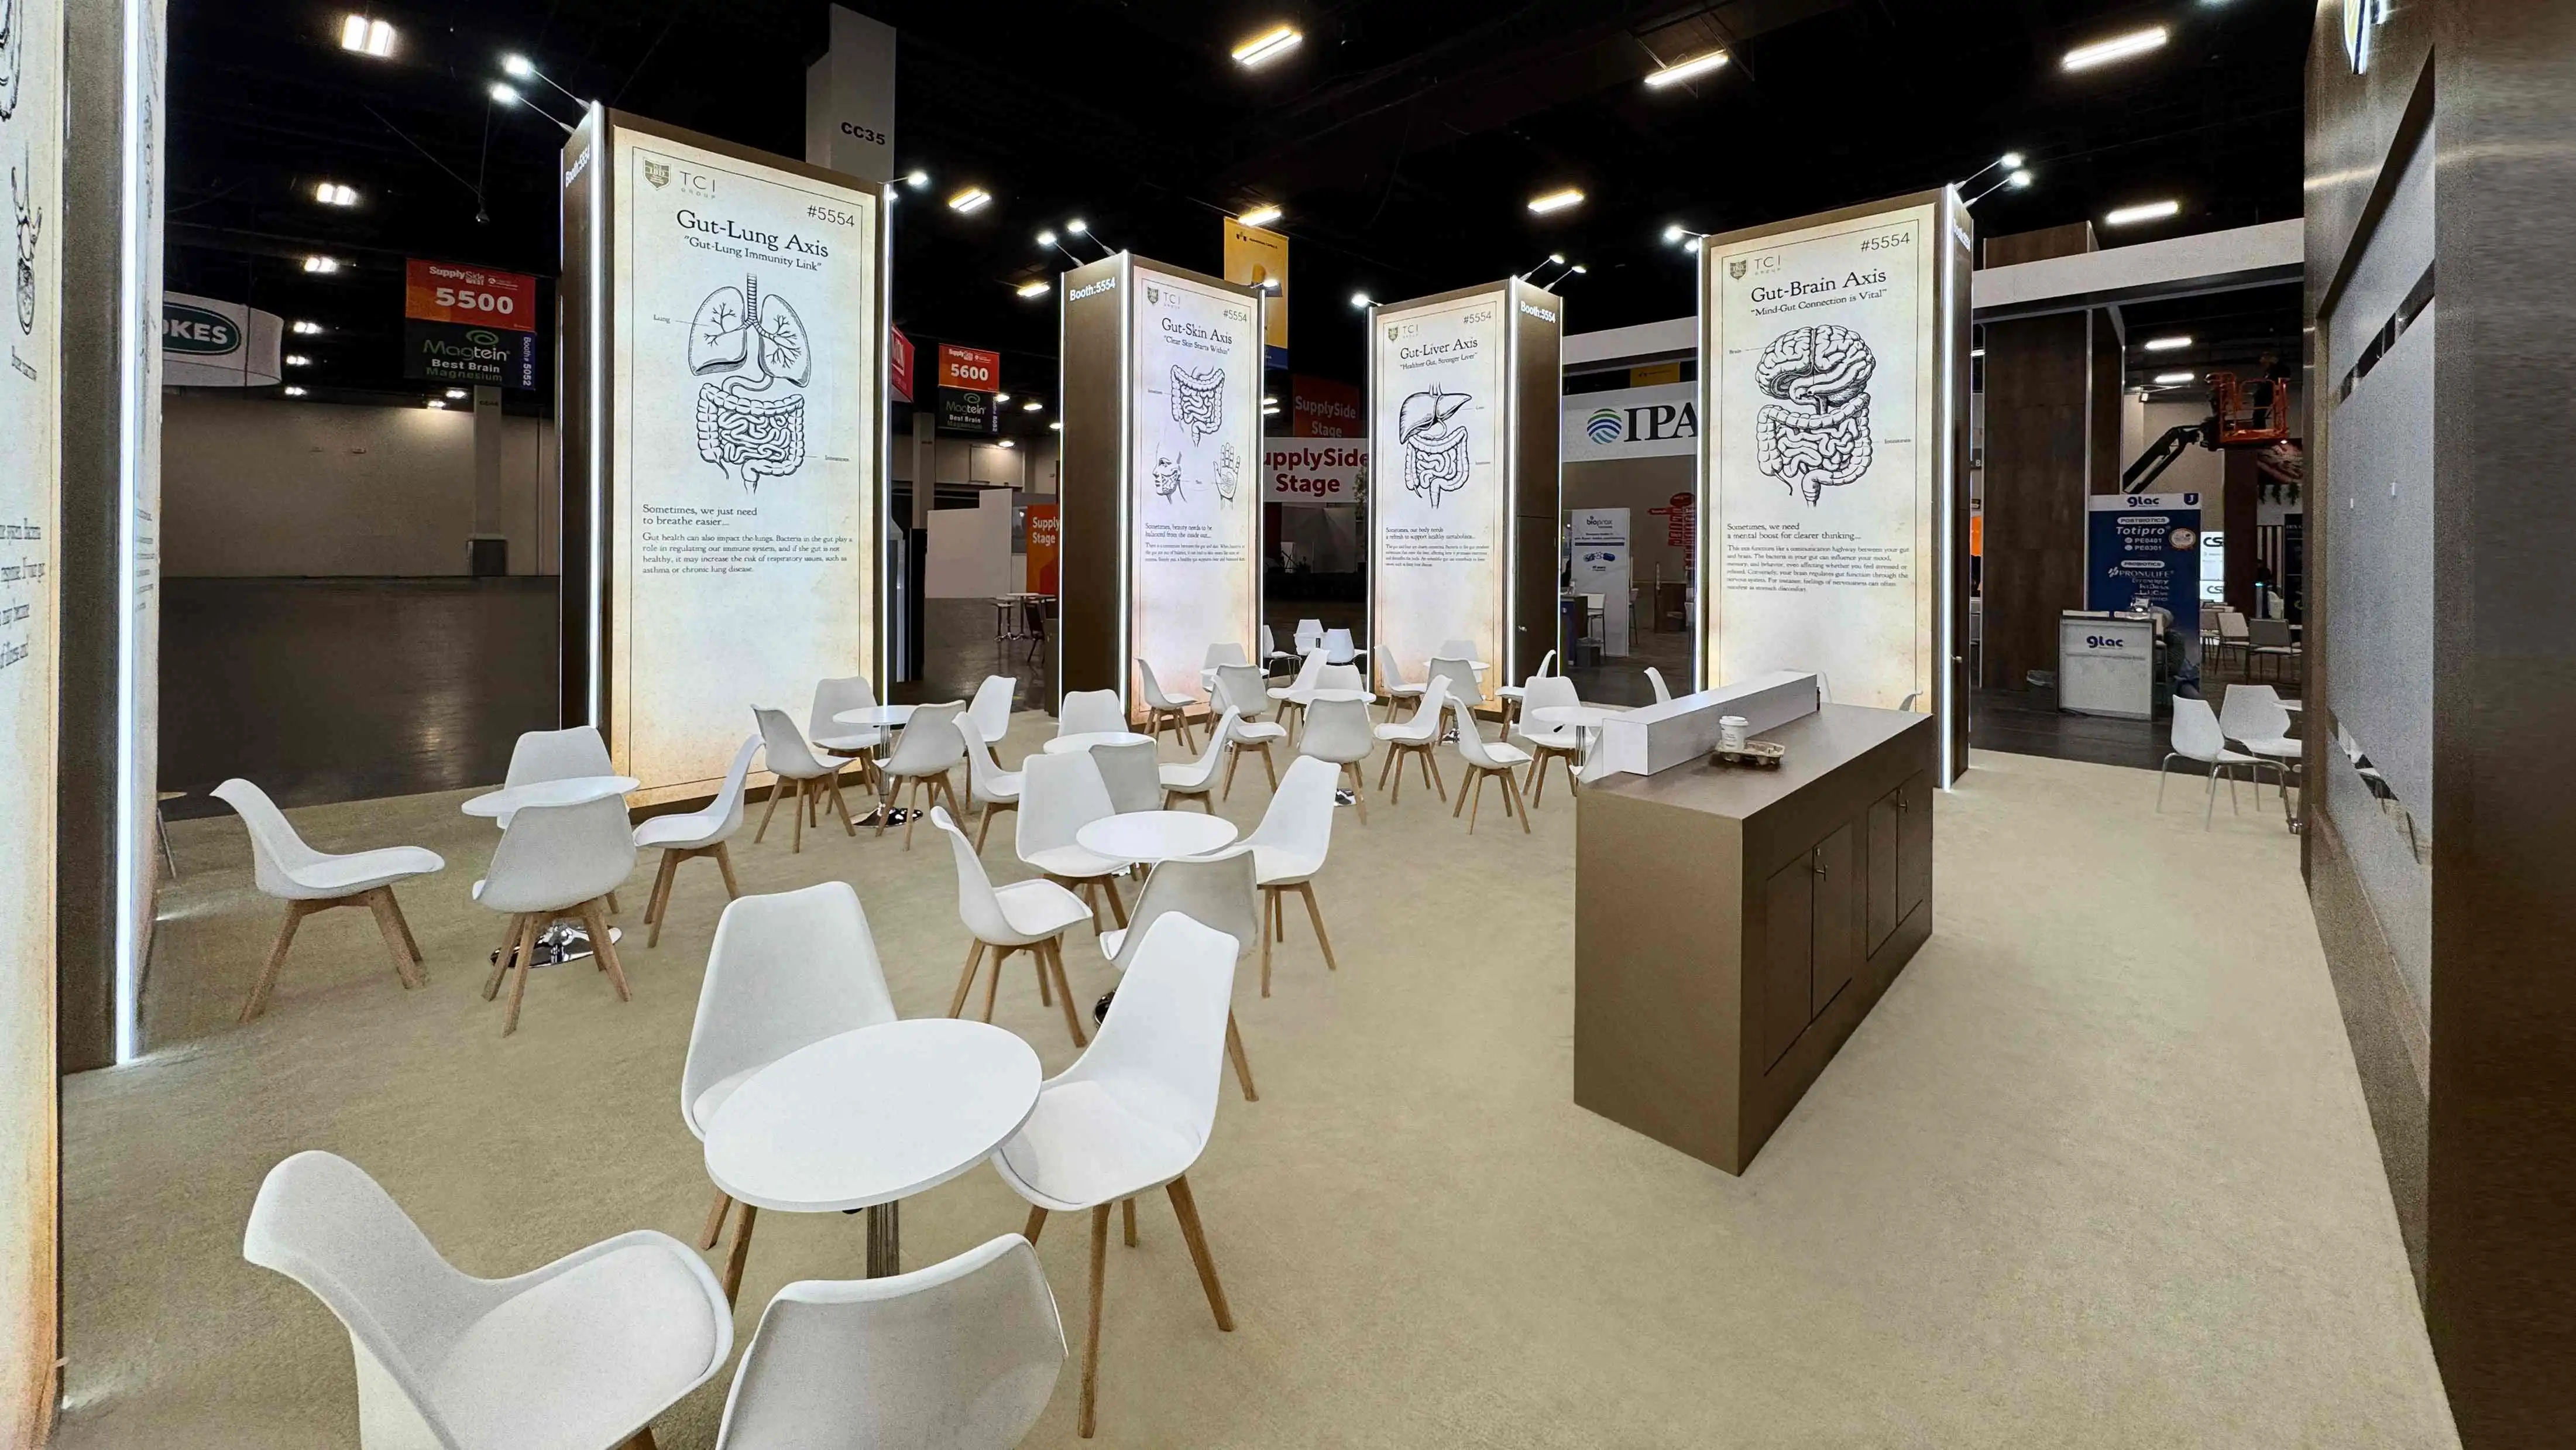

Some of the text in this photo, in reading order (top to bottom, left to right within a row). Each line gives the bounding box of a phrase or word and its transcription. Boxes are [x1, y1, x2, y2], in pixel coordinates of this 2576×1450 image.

[842, 122, 885, 145] CC35
[679, 171, 716, 193] TCI
[681, 187, 716, 200] GROUP
[807, 205, 855, 227] #5554
[676, 210, 829, 258] Gut-Lung Axis
[1861, 232, 1910, 252] #5554
[745, 248, 793, 267] Immunity
[1754, 255, 1781, 270] TCI
[1070, 276, 1115, 301] Booth:5554
[1751, 268, 1886, 302] Gut-Brain Axis
[436, 287, 514, 314] 5500
[1163, 292, 1180, 305] TCI
[1798, 297, 1846, 310] Connection
[1849, 294, 1856, 302] is
[653, 314, 671, 324] Lung
[1223, 309, 1247, 322] #5554
[1464, 311, 1491, 324] #5554
[1521, 300, 1556, 323] Booth:5554
[1162, 317, 1232, 344] Gut-Skin Axis
[1403, 324, 1418, 334] TCI
[1400, 337, 1478, 359] Gut-Liver Axis
[432, 358, 500, 373] Best Brain
[951, 363, 988, 381] 5600
[426, 367, 503, 382] Magnesium
[523, 364, 532, 386] 5052
[1295, 396, 1356, 419] SupplySide
[1312, 421, 1342, 438] Stage
[1624, 402, 1697, 442] IPA
[1276, 474, 1340, 497] Stage
[2127, 496, 2160, 508] glac
[2187, 495, 2194, 503] J
[643, 504, 698, 515] Sometimes,
[716, 507, 733, 517] just
[737, 508, 757, 516] need
[657, 516, 693, 525] breathe
[643, 532, 660, 541] Gut
[717, 535, 740, 543] impact
[2116, 526, 2165, 536] Totipro
[1032, 532, 1056, 547] Stage
[669, 545, 706, 553] regulating
[711, 566, 727, 574] lung
[2086, 636, 2124, 649] glac
